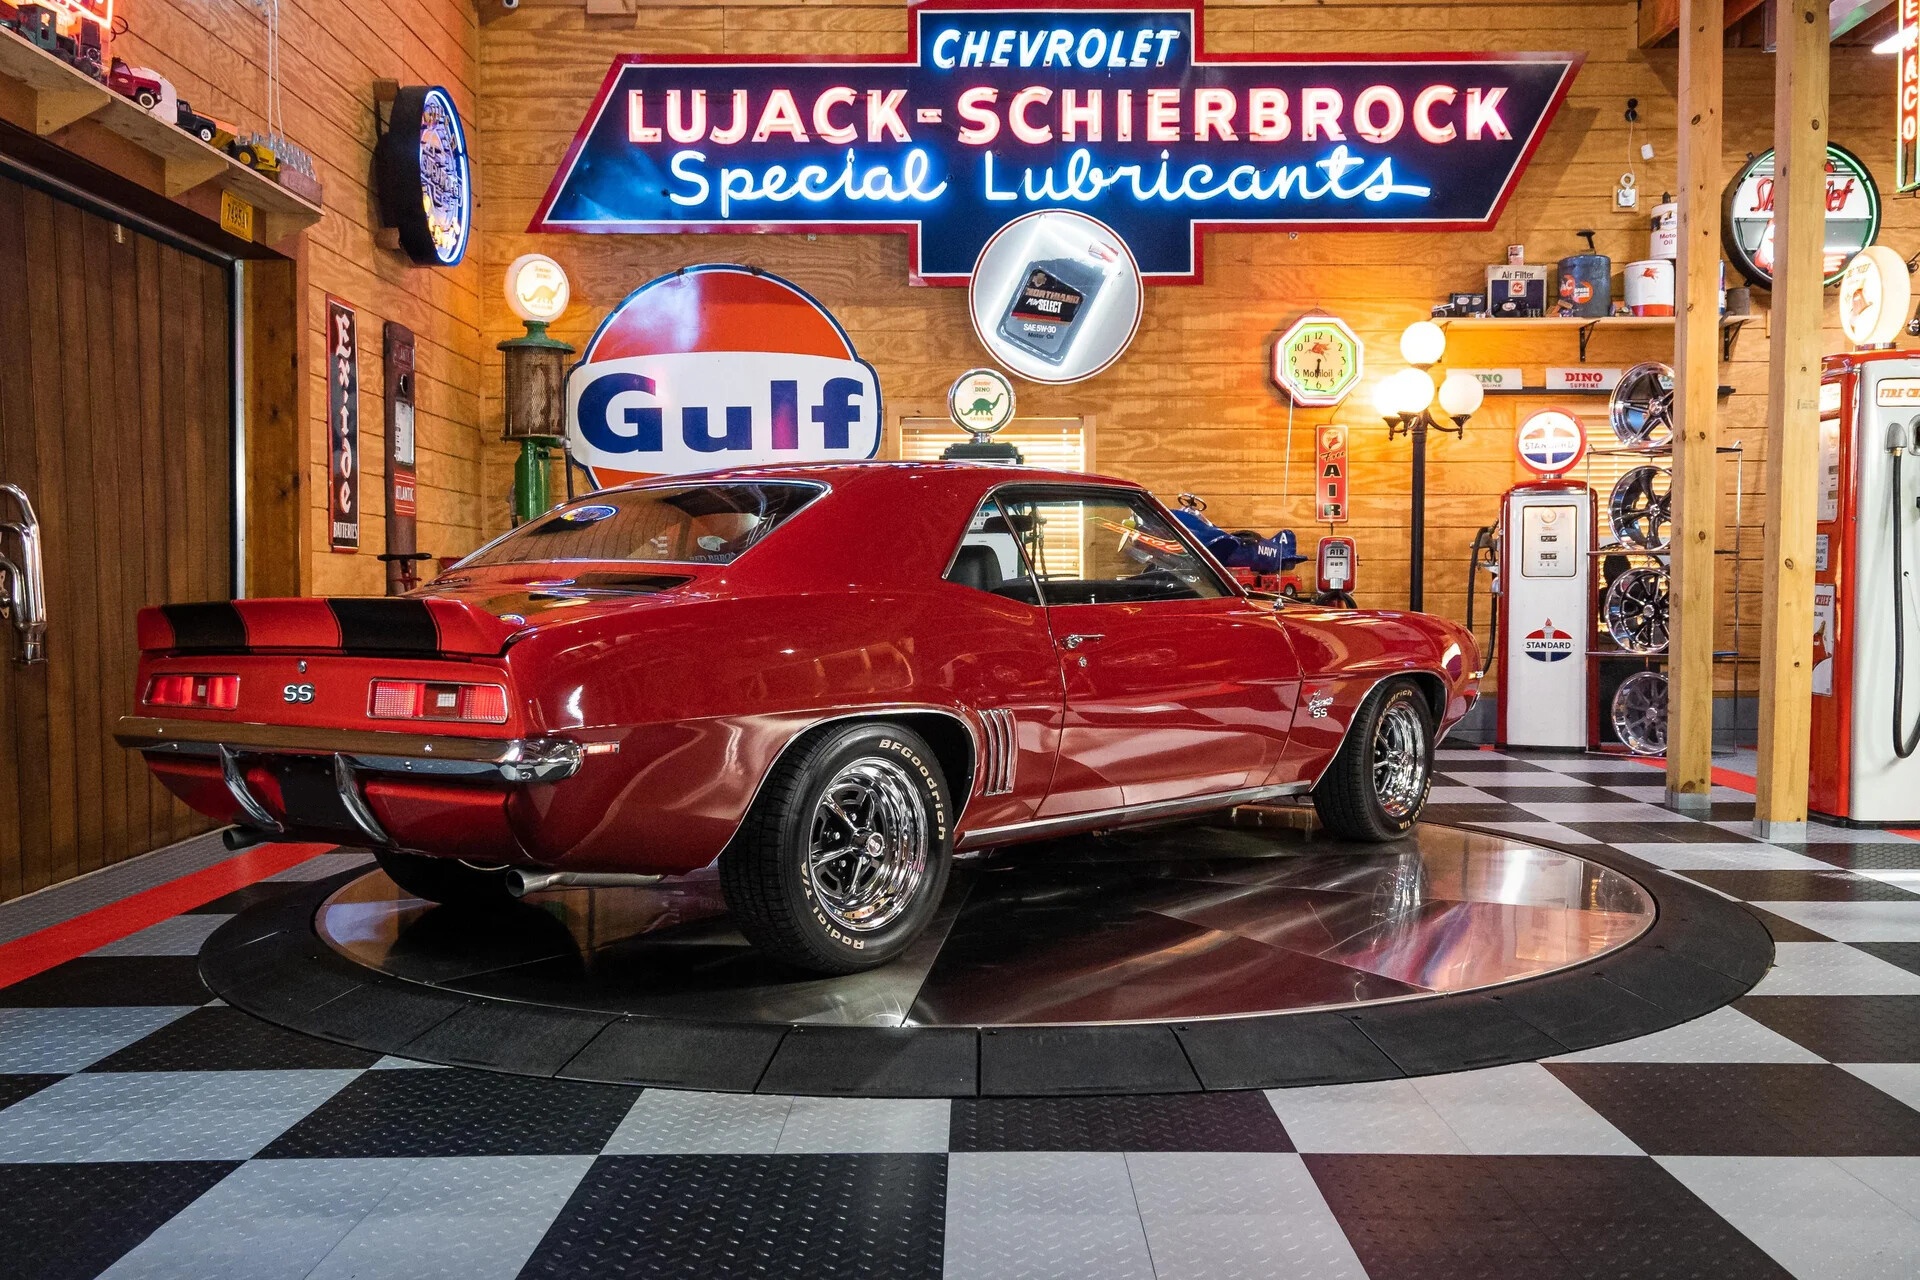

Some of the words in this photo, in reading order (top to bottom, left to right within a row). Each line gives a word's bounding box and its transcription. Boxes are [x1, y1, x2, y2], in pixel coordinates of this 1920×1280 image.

[932, 28, 1181, 69] CHEVROLET
[627, 84, 1513, 145] LUJACK-SCHIERBROCK
[669, 147, 948, 218] Special
[985, 144, 1431, 202] Lubricants
[1502, 271, 1512, 279] Air
[1515, 271, 1534, 279] Filter
[1038, 298, 1063, 314] SELECT
[1023, 323, 1036, 332] SAE
[1314, 332, 1323, 340] 12
[1338, 343, 1343, 351] 2
[1291, 356, 1297, 365] 9
[1341, 356, 1346, 365] 3
[1294, 369, 1300, 377] 8
[1338, 369, 1343, 377] 4
[1565, 372, 1603, 382] DINO
[1316, 381, 1321, 389] 6
[1330, 378, 1335, 386] 5
[1880, 388, 1904, 398] FIRE
[577, 372, 864, 454] Gulf
[1319, 451, 1345, 461] Free
[395, 485, 414, 502] ATLANTIC
[1323, 464, 1341, 517] AIR
[333, 521, 359, 540] BATTERIES
[1279, 532, 1288, 545] A
[1257, 545, 1278, 558] NAVY
[1526, 641, 1571, 649] STANDARD
[283, 684, 312, 702] SS
[1313, 707, 1328, 719] SS
[878, 739, 946, 841] BFGoodrich
[800, 861, 813, 901] T/A
[813, 906, 865, 950] Radial
